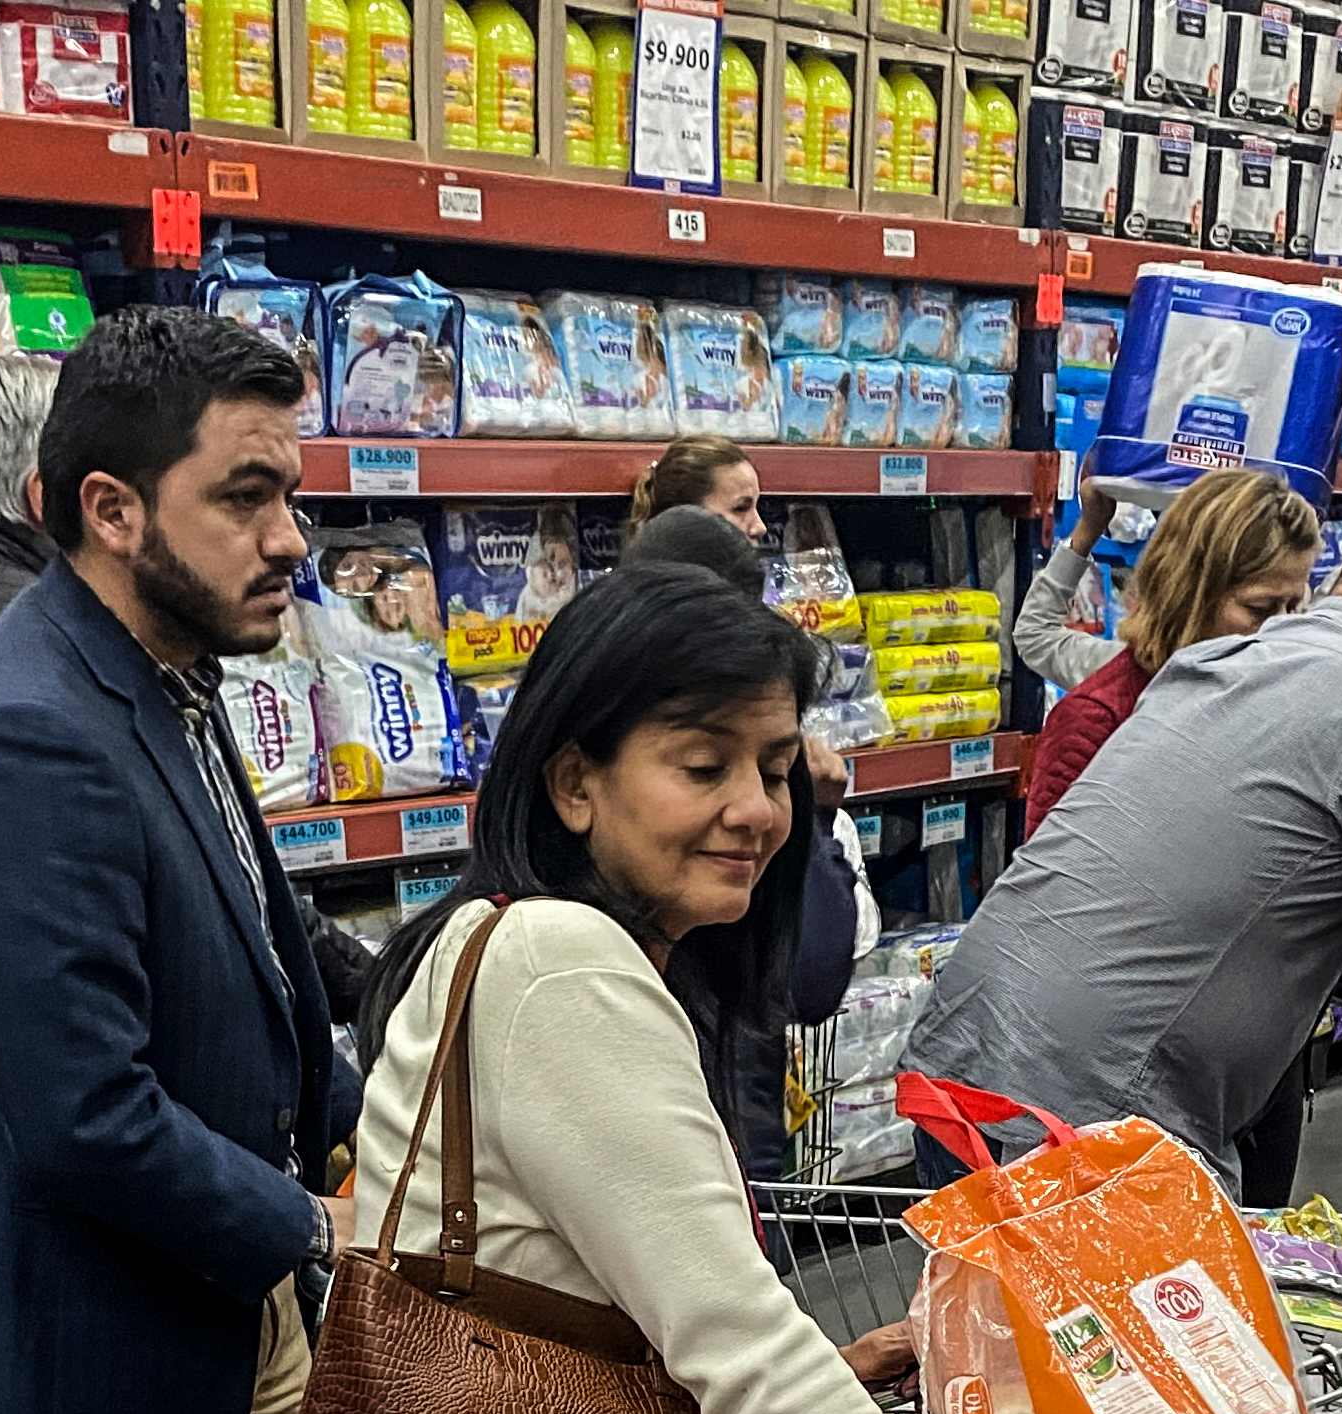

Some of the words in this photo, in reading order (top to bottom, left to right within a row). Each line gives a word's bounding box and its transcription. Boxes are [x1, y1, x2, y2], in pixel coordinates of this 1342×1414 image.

[644, 38, 710, 71] $9.900
[675, 213, 699, 232] 415
[357, 448, 413, 466] $28.900
[478, 530, 530, 563] winny
[371, 661, 413, 763] winny
[252, 680, 284, 772] winny
[406, 806, 461, 828] $49.100
[278, 821, 337, 844] $44.700
[963, 1391, 984, 1414] 10
